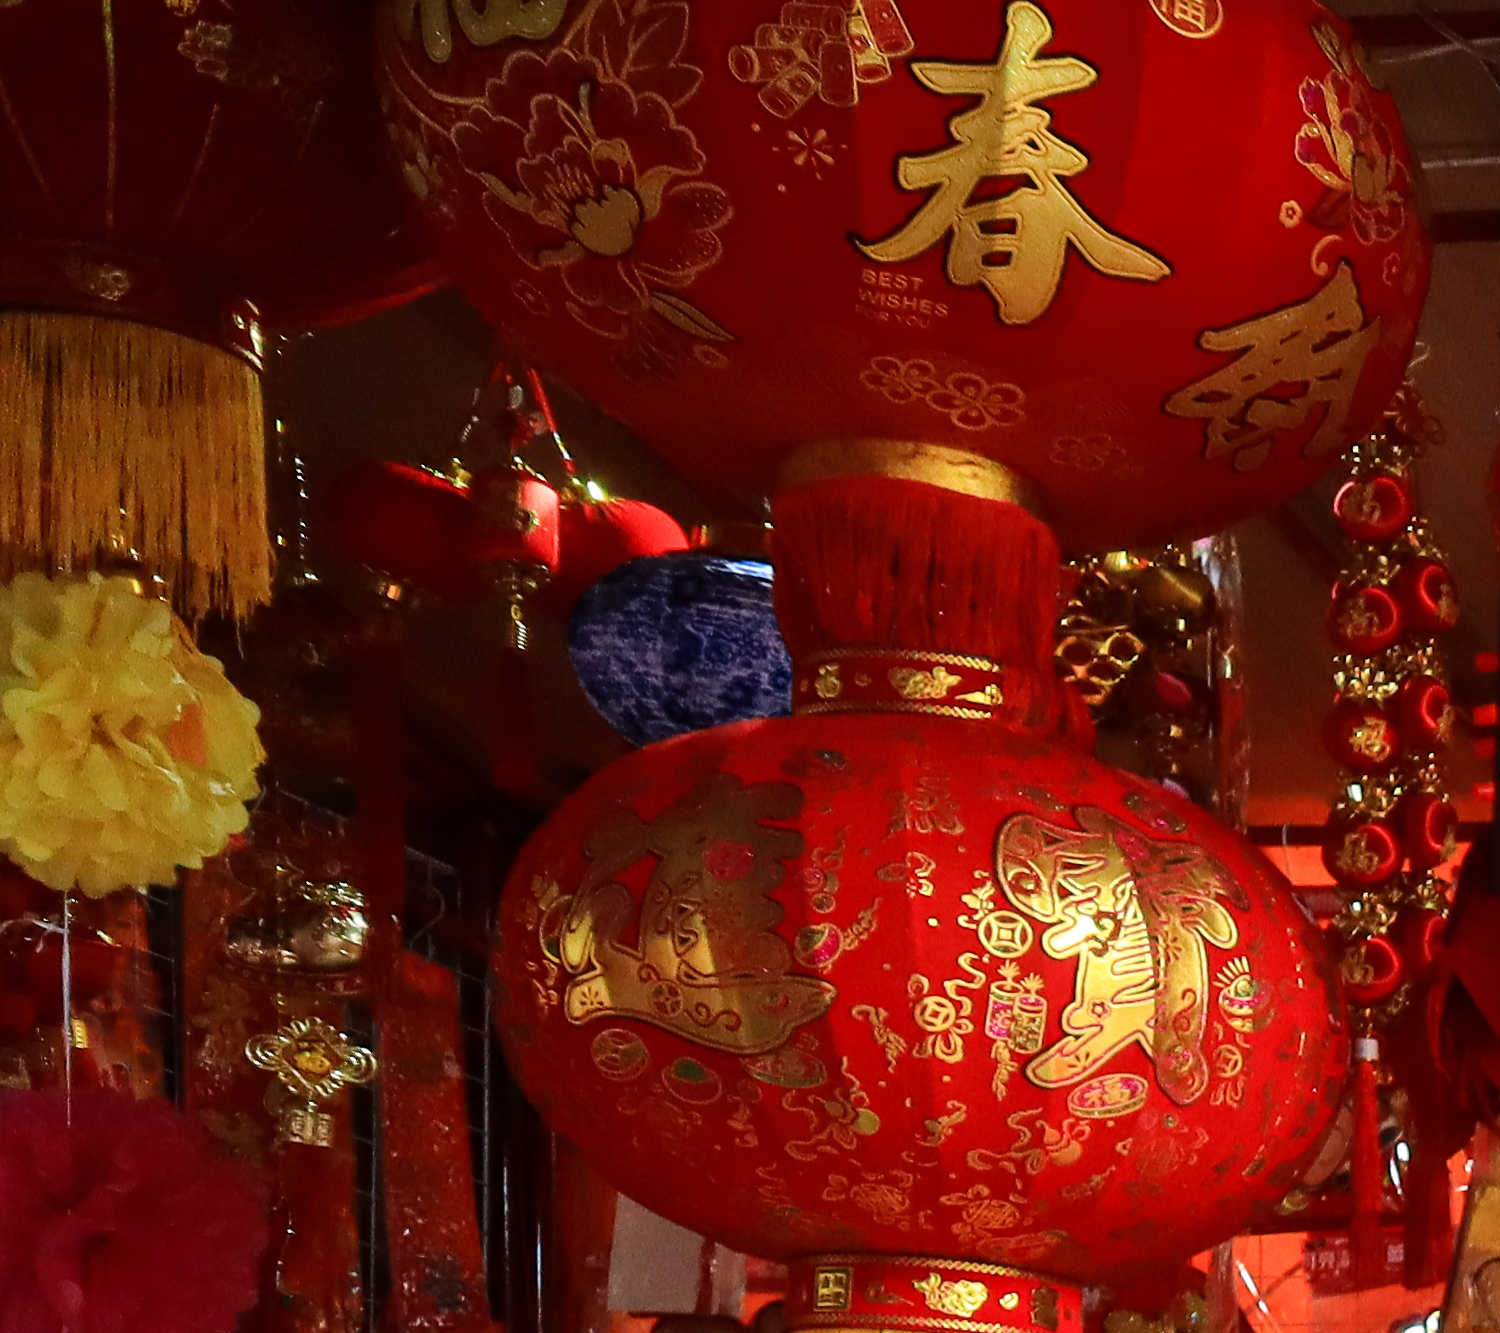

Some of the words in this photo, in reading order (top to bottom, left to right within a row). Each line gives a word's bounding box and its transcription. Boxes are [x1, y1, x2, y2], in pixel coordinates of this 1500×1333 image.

[853, 2, 1171, 323] 春
[862, 269, 923, 291] BEST
[858, 288, 949, 318] WISHES
